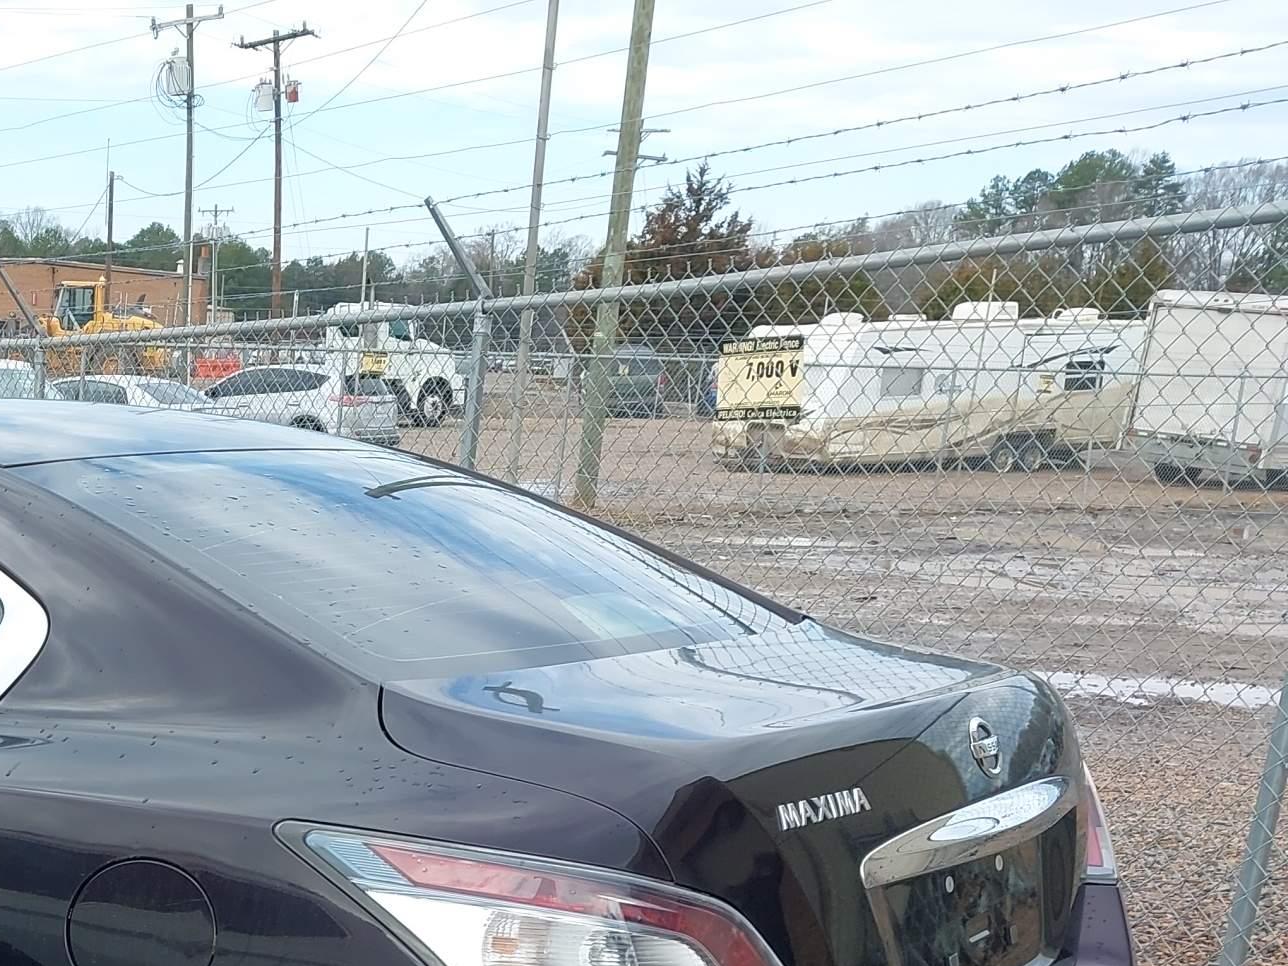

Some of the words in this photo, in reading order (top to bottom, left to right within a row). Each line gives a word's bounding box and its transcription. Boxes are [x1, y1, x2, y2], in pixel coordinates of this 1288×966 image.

[746, 360, 784, 381] 7,000
[789, 359, 800, 377] V
[747, 409, 765, 418] Ceca
[765, 407, 797, 418] Eltrica
[778, 787, 872, 831] MAXIMA
